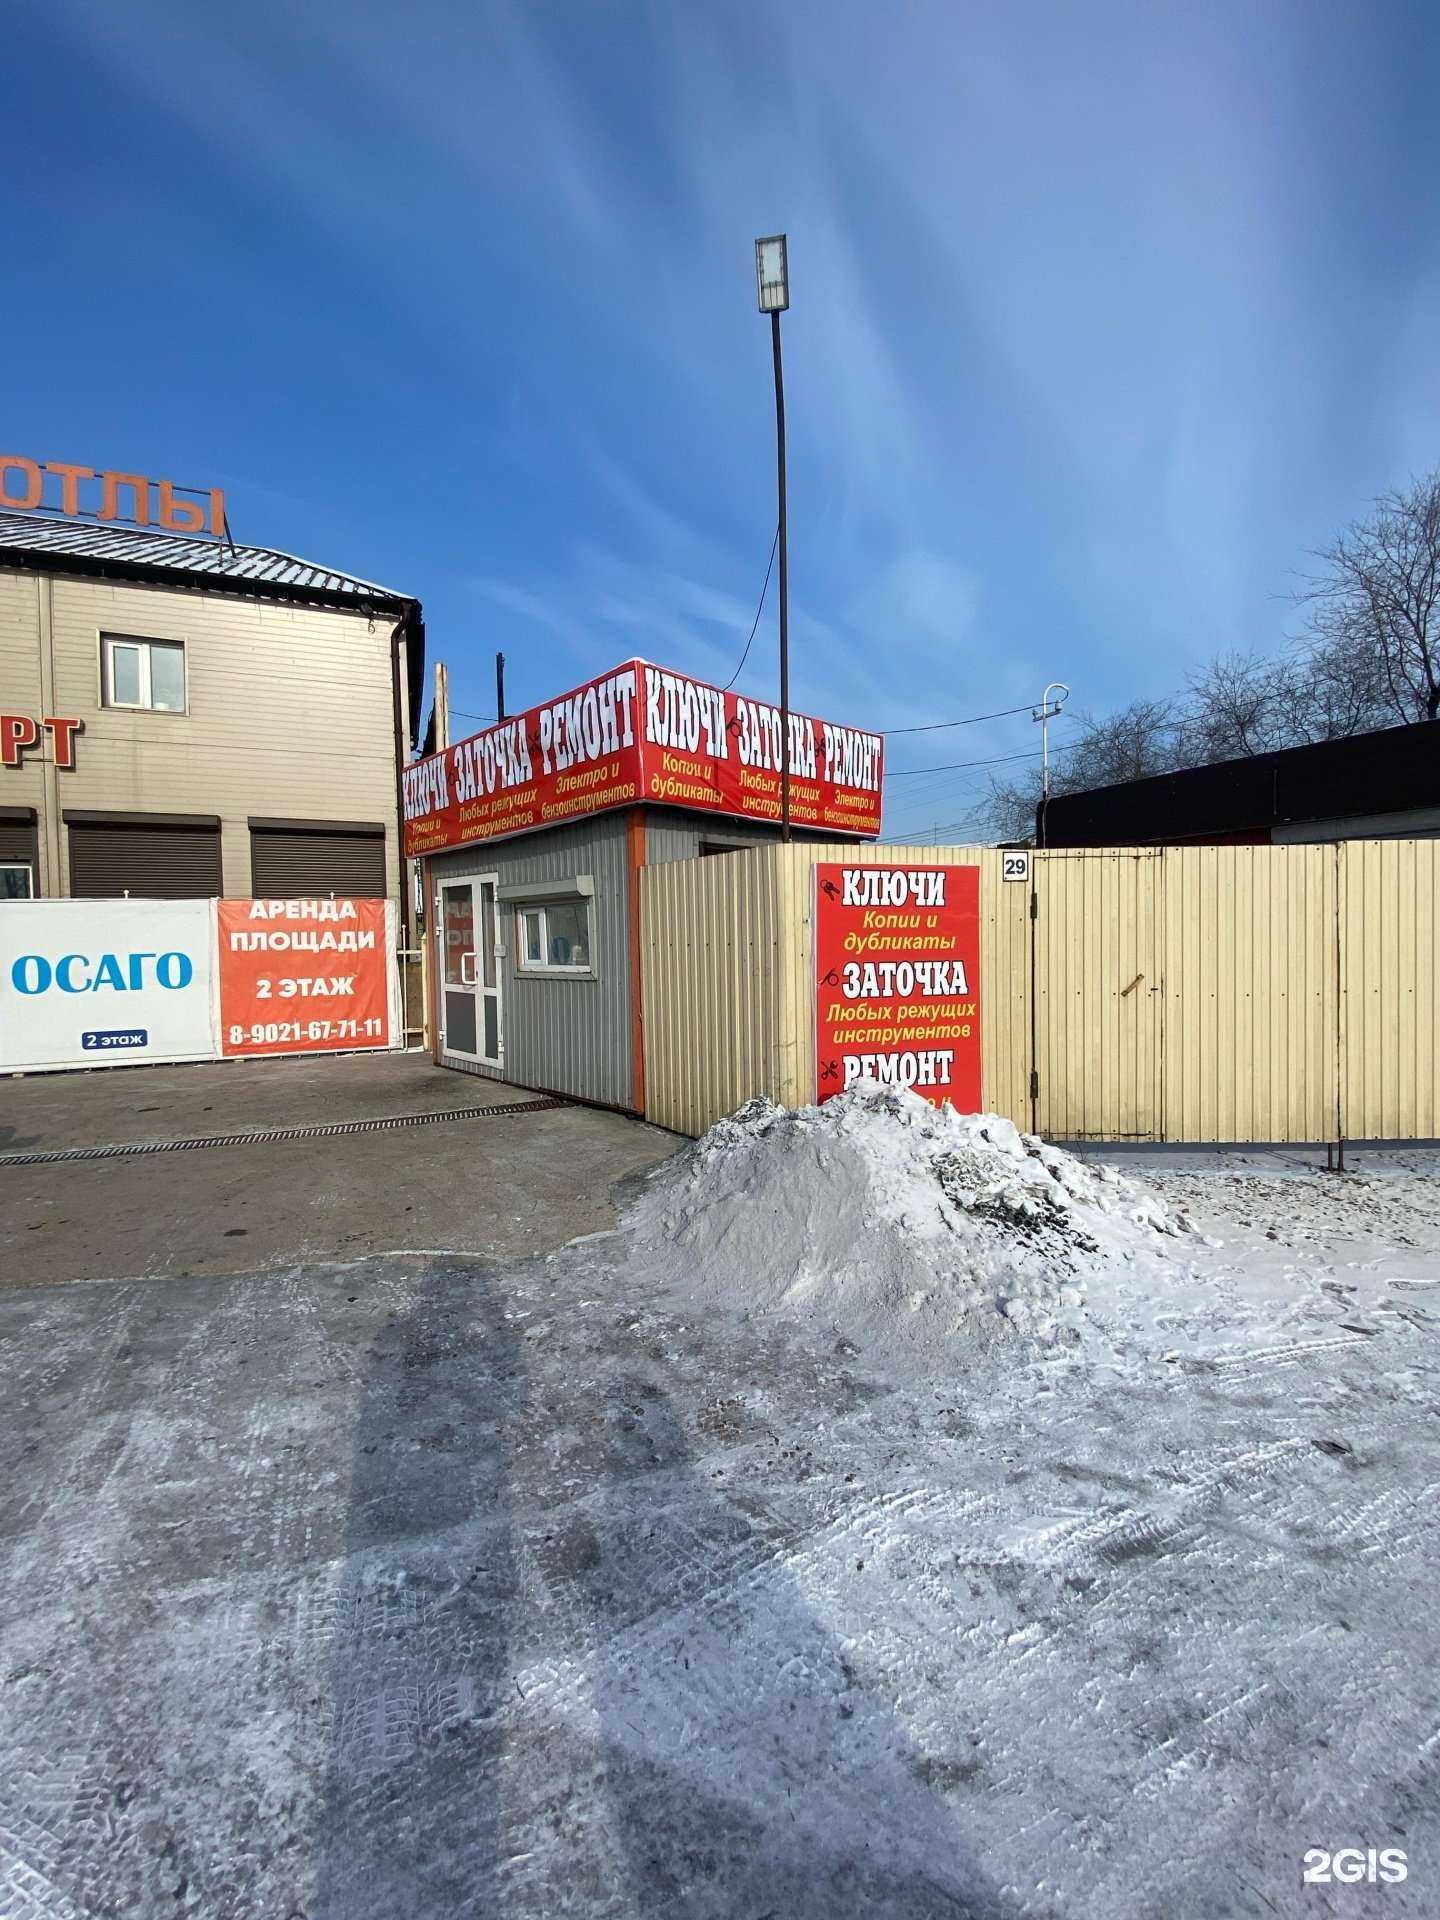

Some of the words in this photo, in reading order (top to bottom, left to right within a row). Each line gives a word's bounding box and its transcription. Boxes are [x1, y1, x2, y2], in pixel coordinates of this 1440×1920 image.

[645, 668, 728, 759] КЛЮЧИ
[823, 724, 881, 792] РЕМОНТ
[402, 754, 450, 821] КЛЮЧИ
[454, 718, 533, 803] ЗАТОЧКА
[540, 670, 636, 775] РЕМОНТ
[556, 767, 608, 794] Электро
[612, 762, 620, 777] и
[662, 752, 701, 776] Копии
[704, 766, 712, 780] и
[651, 774, 724, 803] дубликаты
[739, 770, 776, 792] Любых
[778, 782, 821, 802] ржущих
[459, 802, 490, 822] Любых
[491, 788, 537, 817] режущих
[542, 783, 636, 820] бензоинструментов
[743, 795, 818, 820] инструентов
[835, 790, 869, 811] Электро
[870, 799, 876, 810] и
[461, 811, 534, 840] инструментов
[1005, 859, 1026, 875] 29
[842, 869, 946, 906] КЛЮЧИ
[249, 900, 358, 922] АРЕНДА
[863, 911, 920, 928] Копии
[927, 914, 938, 928] и
[230, 931, 376, 953] ПЛОЩАДИ
[844, 932, 956, 955] дубликаты
[11, 952, 193, 995] ОСАГО
[256, 979, 272, 999] 2
[278, 976, 357, 998] ЭТАЖ
[842, 960, 969, 999] ЗАТОЧКА
[826, 1003, 893, 1022] Любых
[896, 1003, 976, 1023] режущих
[87, 1035, 98, 1047] 2
[101, 1033, 143, 1046] этаж
[229, 1018, 383, 1045] 8-9021-67-71-11
[833, 1024, 971, 1045] инструментов
[842, 1050, 954, 1091] РЕМОНТ
